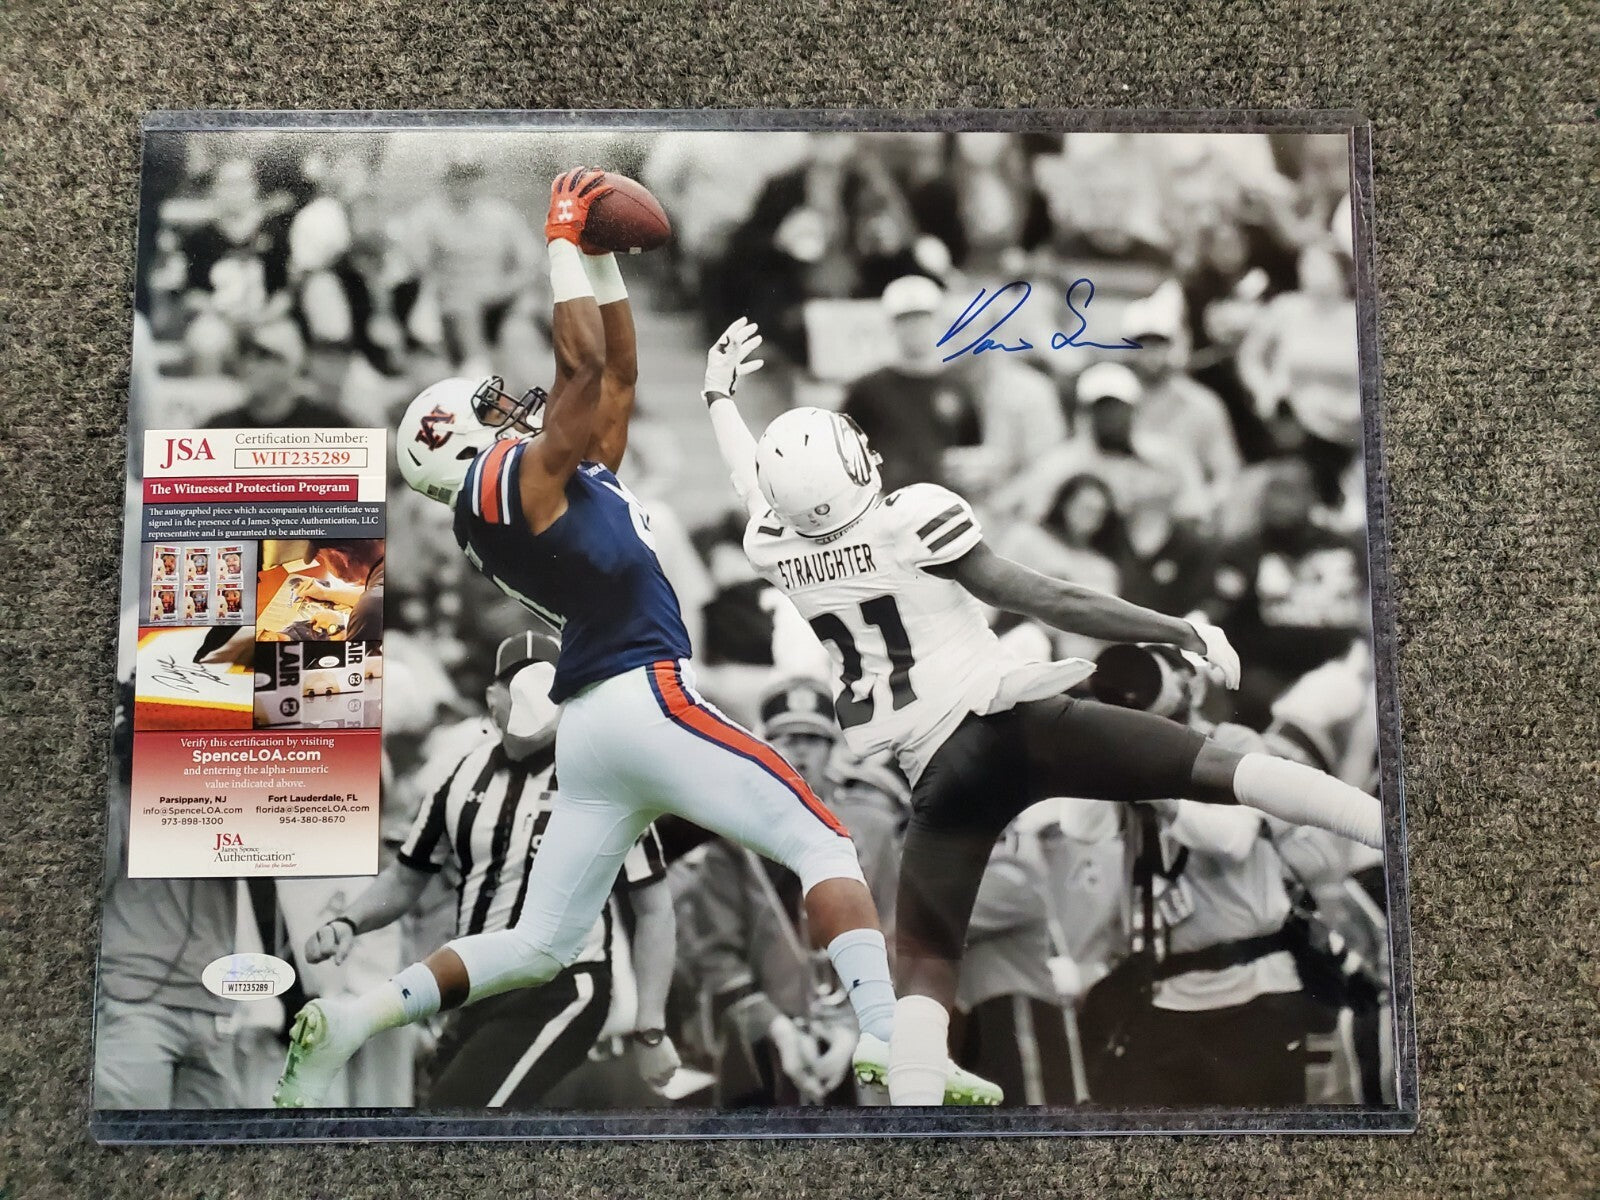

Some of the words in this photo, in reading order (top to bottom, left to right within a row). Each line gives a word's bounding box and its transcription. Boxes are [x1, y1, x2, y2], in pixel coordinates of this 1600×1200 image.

[235, 433, 309, 444] Certification
[314, 433, 368, 443] Number:
[160, 438, 215, 469] JSA
[253, 452, 350, 465] WIT235289
[151, 484, 171, 494] The
[174, 483, 232, 494] Witnessed
[235, 483, 295, 493] Protection
[299, 482, 349, 495] Program
[165, 507, 211, 516] autographed
[213, 507, 232, 516] piece
[234, 506, 257, 514] which
[259, 506, 307, 515] accompanies
[325, 505, 362, 513] certificate
[149, 519, 172, 528] signed
[198, 519, 230, 527] presence
[248, 517, 269, 525] James
[272, 517, 298, 526] Spence
[300, 517, 359, 525] Authentication,
[149, 530, 199, 538] representative
[225, 529, 267, 537] guaranteed
[778, 544, 876, 589] STRAUGHTER
[181, 739, 207, 749] Verify
[210, 738, 227, 746] this
[229, 738, 284, 746] certification
[286, 738, 297, 748] by
[300, 738, 334, 747] visiting
[192, 750, 321, 763] SpenceLOA.com
[184, 766, 200, 775] and
[203, 766, 241, 776] entering
[244, 766, 258, 774] the
[261, 765, 328, 775] alpha-numeric
[205, 780, 229, 788] value
[232, 779, 274, 787] indicated
[276, 779, 306, 787] above.
[160, 797, 212, 805] Parsippany,
[290, 794, 344, 803] Lauderdale,
[143, 807, 242, 815] info@SpenceLOA.com
[256, 805, 370, 814] florida@SpenceLOA.com
[213, 833, 243, 850] JSA
[228, 984, 268, 992] WIT235289
